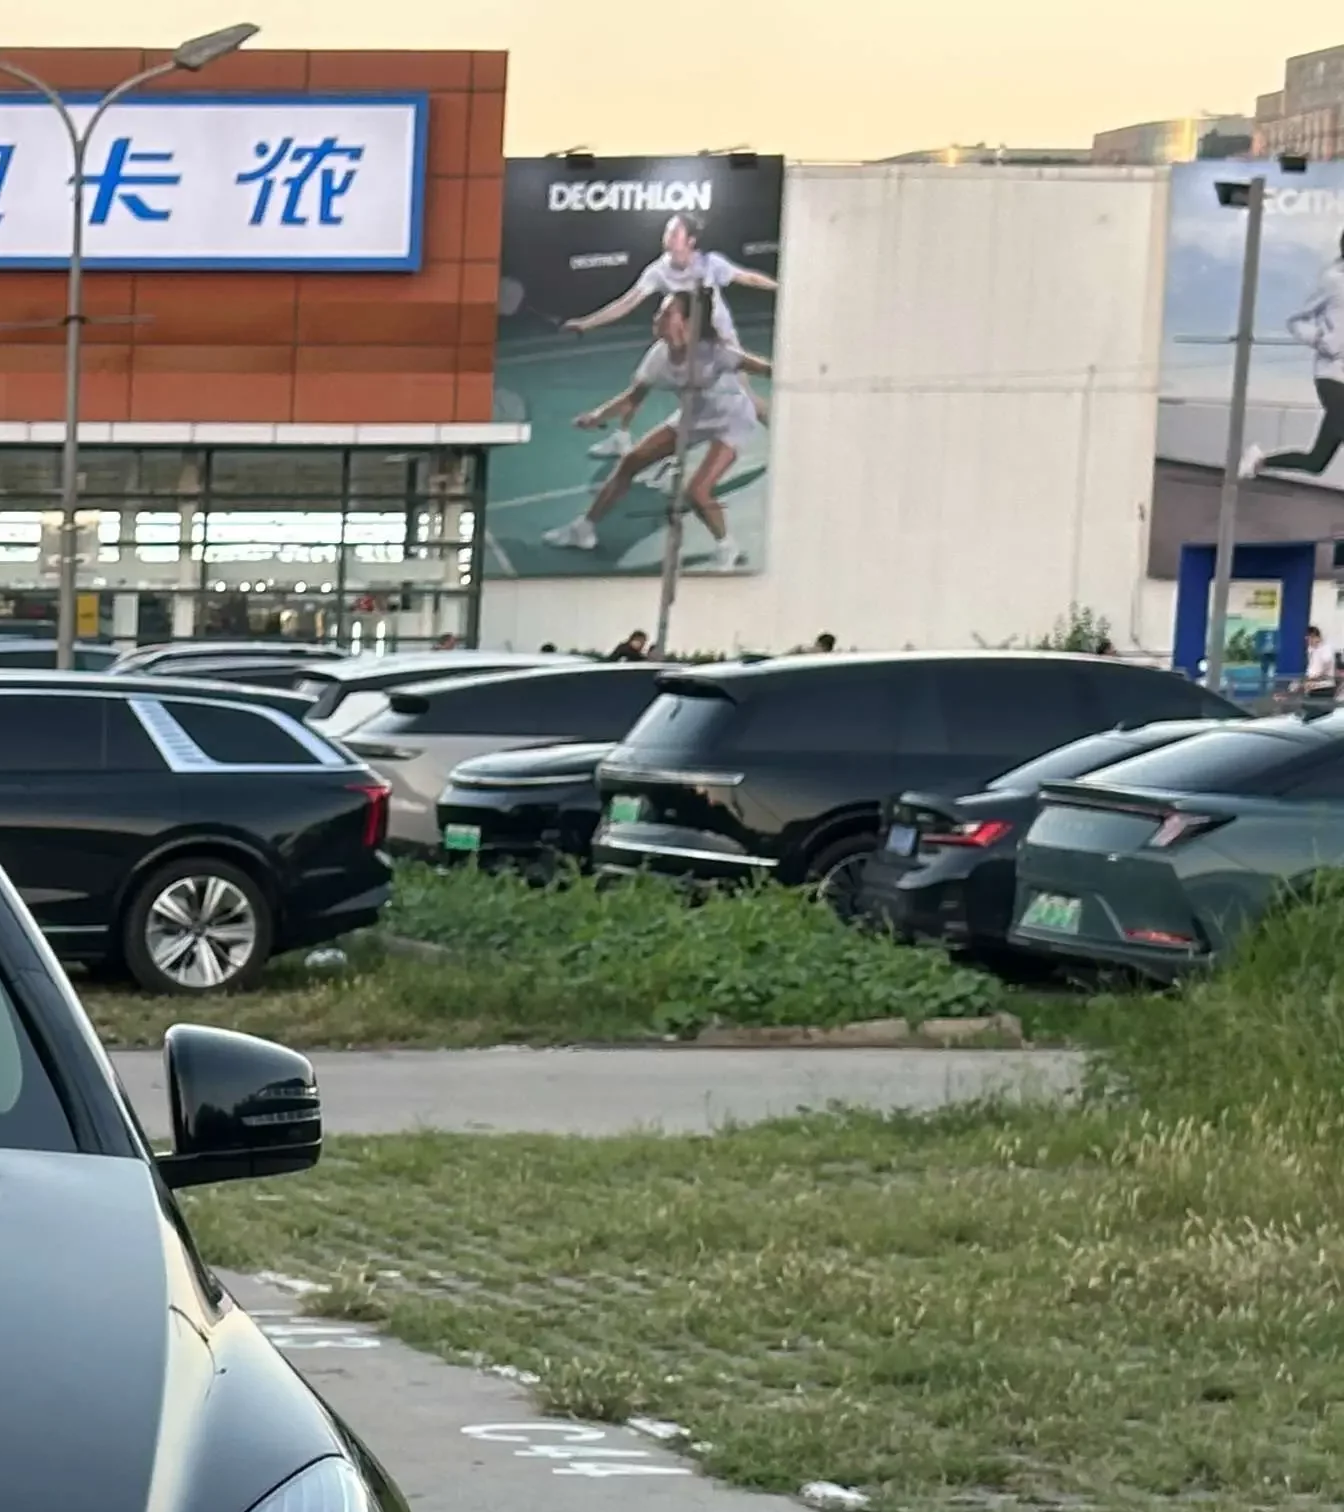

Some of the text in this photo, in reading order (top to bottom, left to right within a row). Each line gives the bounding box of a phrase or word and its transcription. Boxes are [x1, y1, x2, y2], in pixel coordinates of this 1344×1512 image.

[548, 180, 712, 211] DECATHLON
[1248, 187, 1344, 216] ECATH
[460, 1421, 693, 1478] C44
